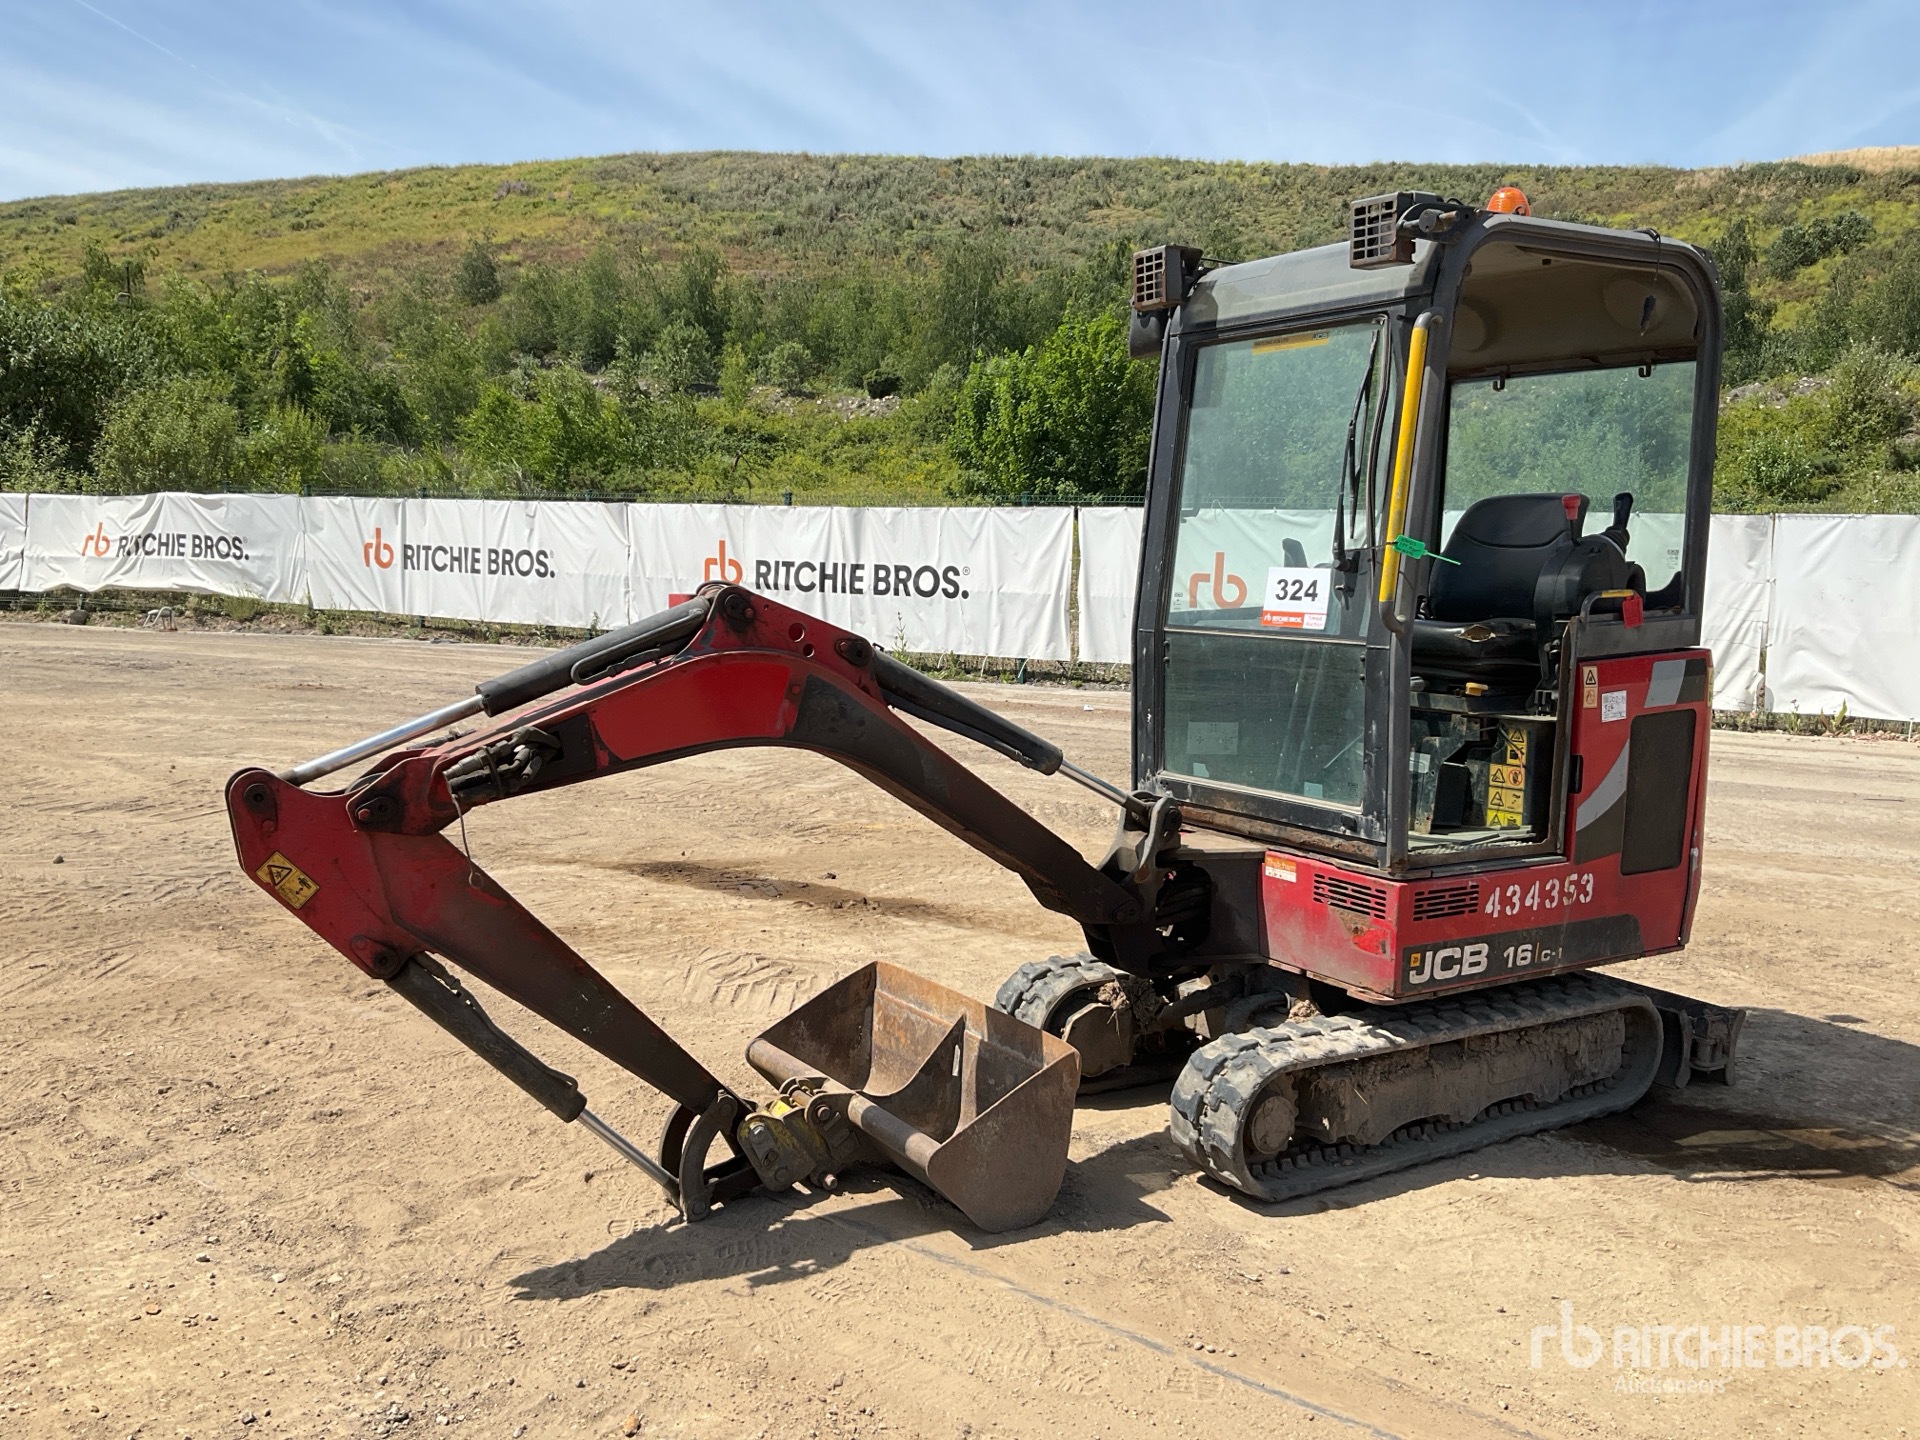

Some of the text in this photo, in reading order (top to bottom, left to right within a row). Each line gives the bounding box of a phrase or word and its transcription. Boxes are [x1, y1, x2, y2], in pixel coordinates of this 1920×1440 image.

[82, 521, 110, 557] rb
[363, 527, 395, 569] rb
[403, 544, 481, 574] RITCHIE
[755, 559, 865, 595] RITCHIE
[1275, 578, 1318, 601] 324
[1485, 872, 1594, 918] 434353
[1409, 943, 1489, 984] JCB
